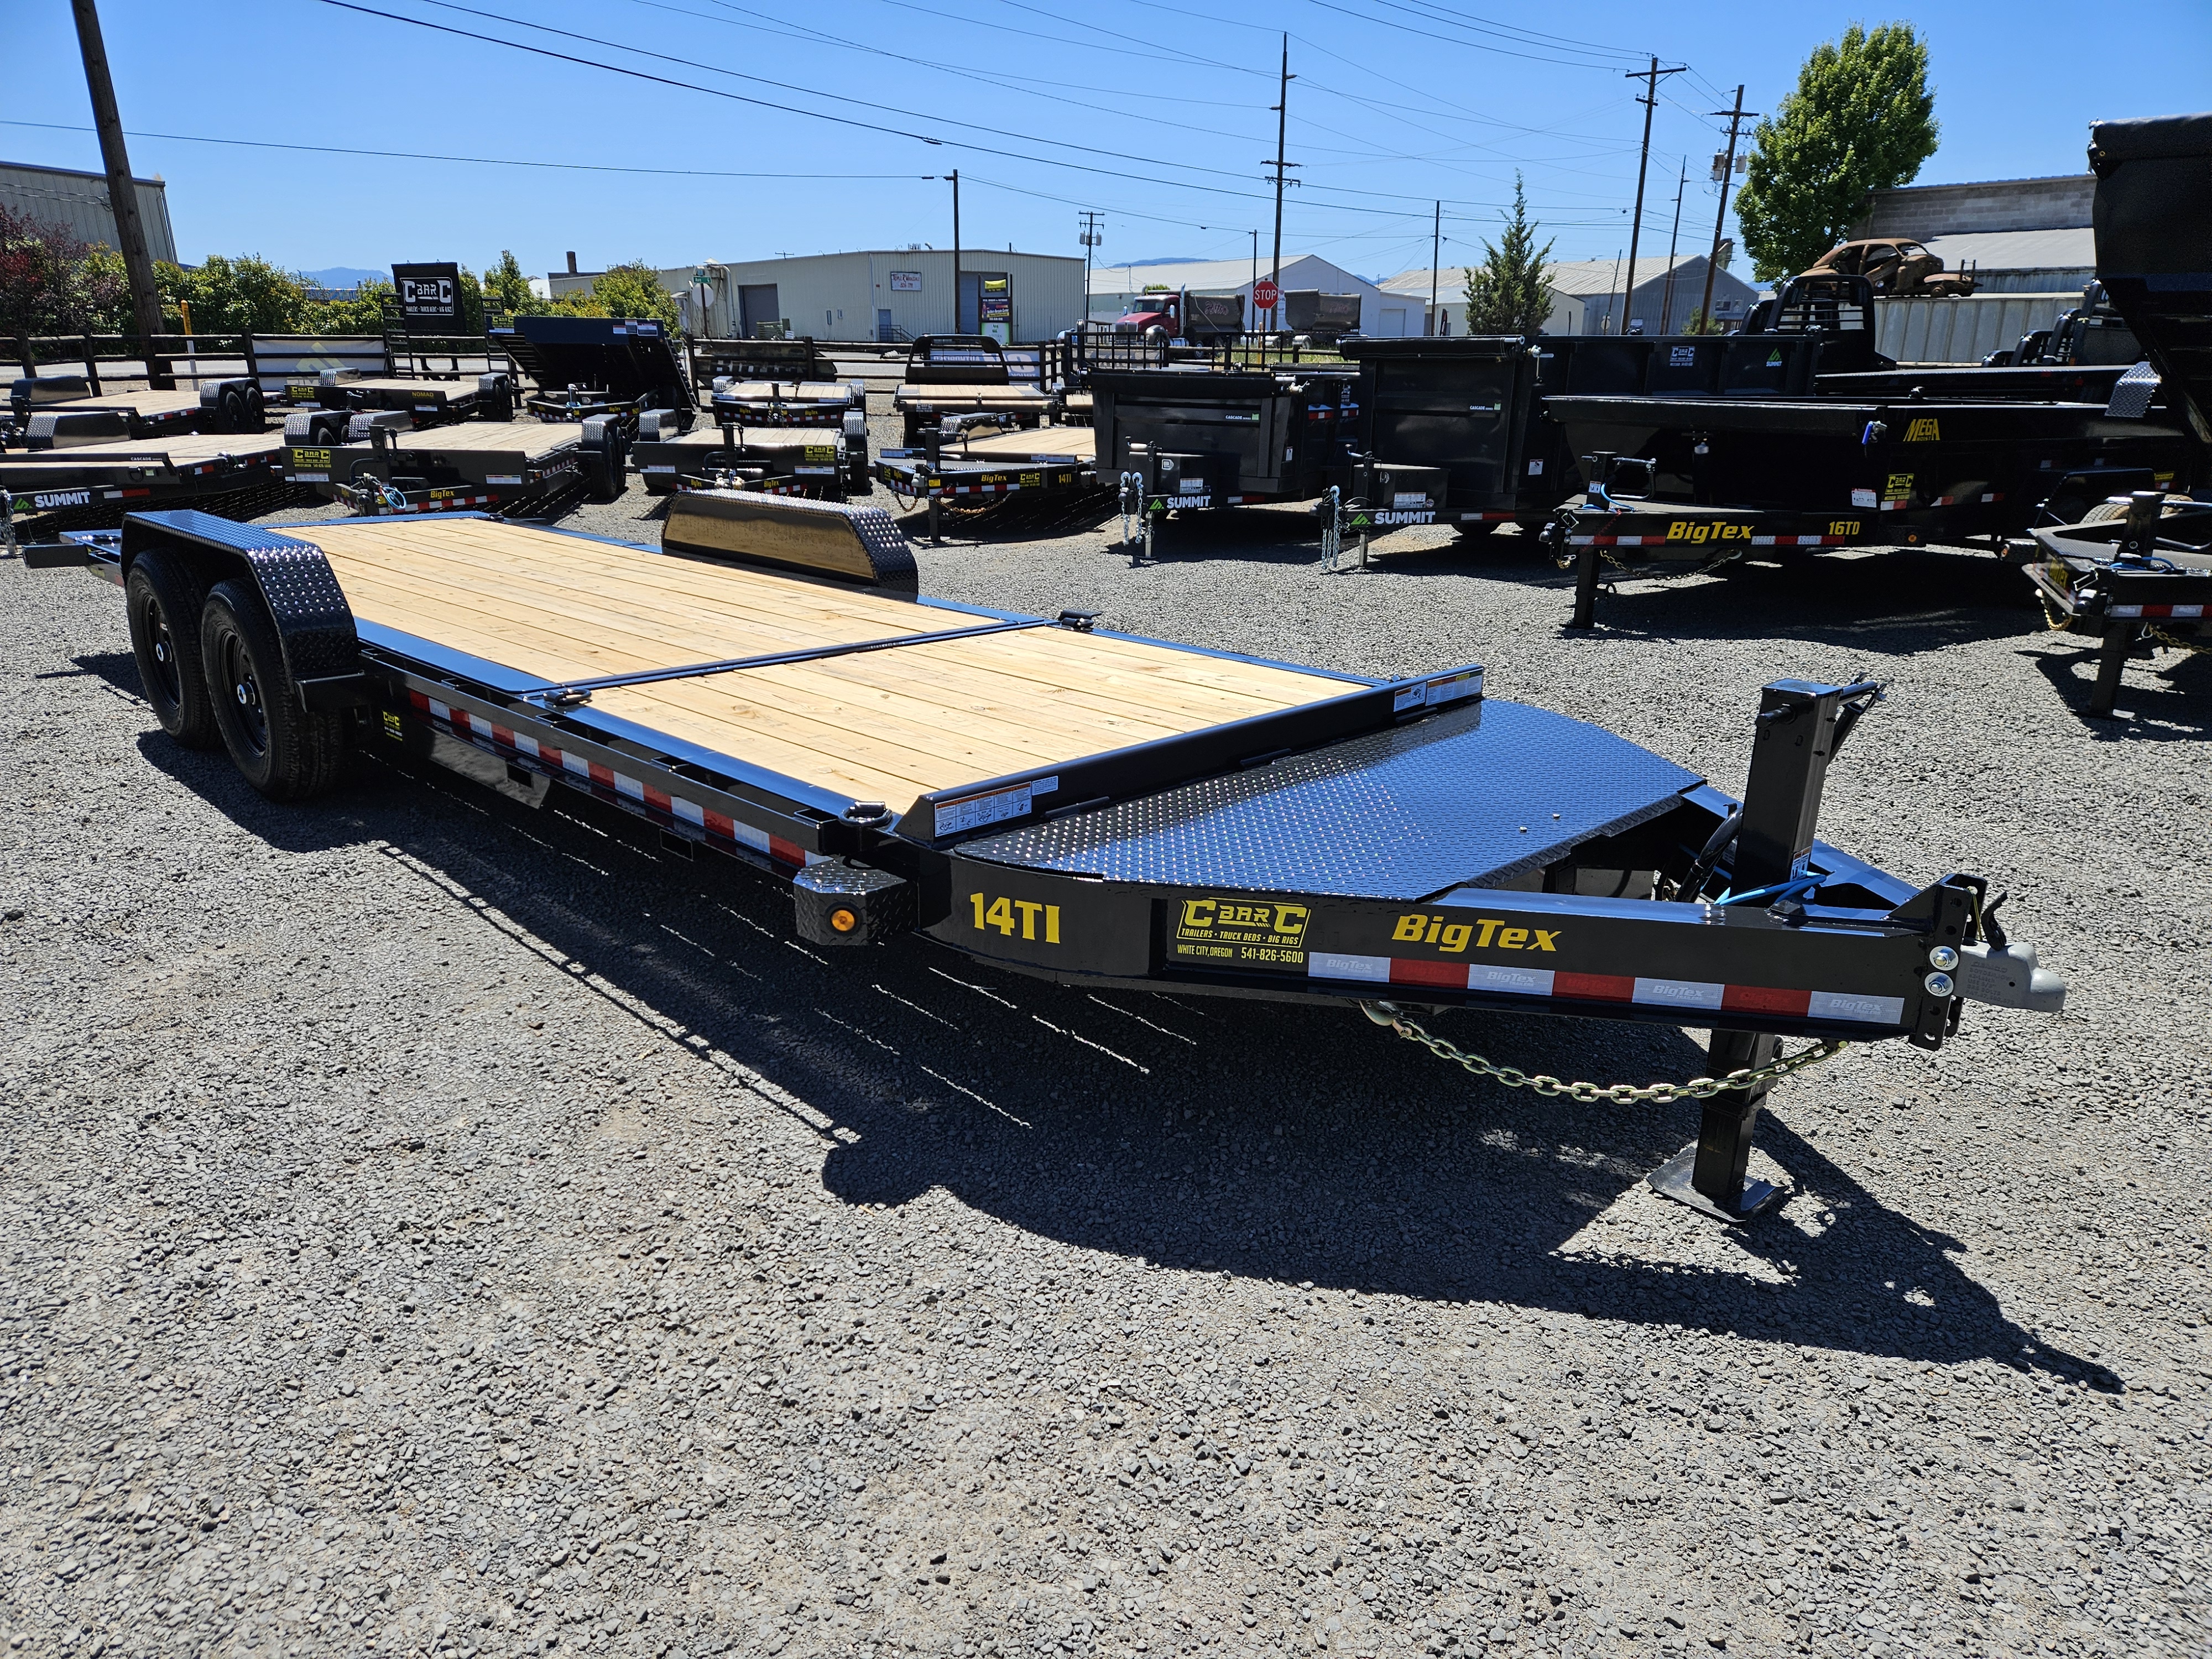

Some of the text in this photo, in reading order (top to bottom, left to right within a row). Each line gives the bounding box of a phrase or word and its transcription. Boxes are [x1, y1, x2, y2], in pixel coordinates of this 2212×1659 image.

[403, 279, 451, 304] C BAR C
[1254, 289, 1277, 301] STOP
[1672, 347, 1679, 357] C
[1688, 347, 1695, 357] C
[1903, 418, 1940, 442] MEGA
[294, 450, 304, 458] C
[320, 450, 329, 460] C
[764, 479, 780, 488] BigTex
[981, 473, 1008, 484] BigTex
[1058, 473, 1072, 483] 14TI
[1887, 476, 1896, 488] C
[1905, 475, 1913, 487] C
[34, 491, 91, 508] SUMMIT
[430, 489, 455, 499] BigTex
[1167, 495, 1211, 509] SUMMIT
[1374, 511, 1436, 525] SUMMIT
[1666, 521, 1755, 544] BigTex
[1829, 521, 1860, 535] 16TD
[969, 892, 1061, 945] 14TI
[1185, 900, 1307, 935] C BAR C
[1181, 927, 1299, 945] TRAILERS TRUCK BEDS BIG RIGS
[1391, 913, 1563, 953] BigTex
[1177, 944, 1195, 956] WHITE
[1241, 946, 1304, 964] 541-826-5600
[1327, 959, 1374, 971] BigTex
[1486, 971, 1536, 984] BigTex
[1652, 985, 1704, 998] BigTex
[1829, 999, 1883, 1011] BigTex
